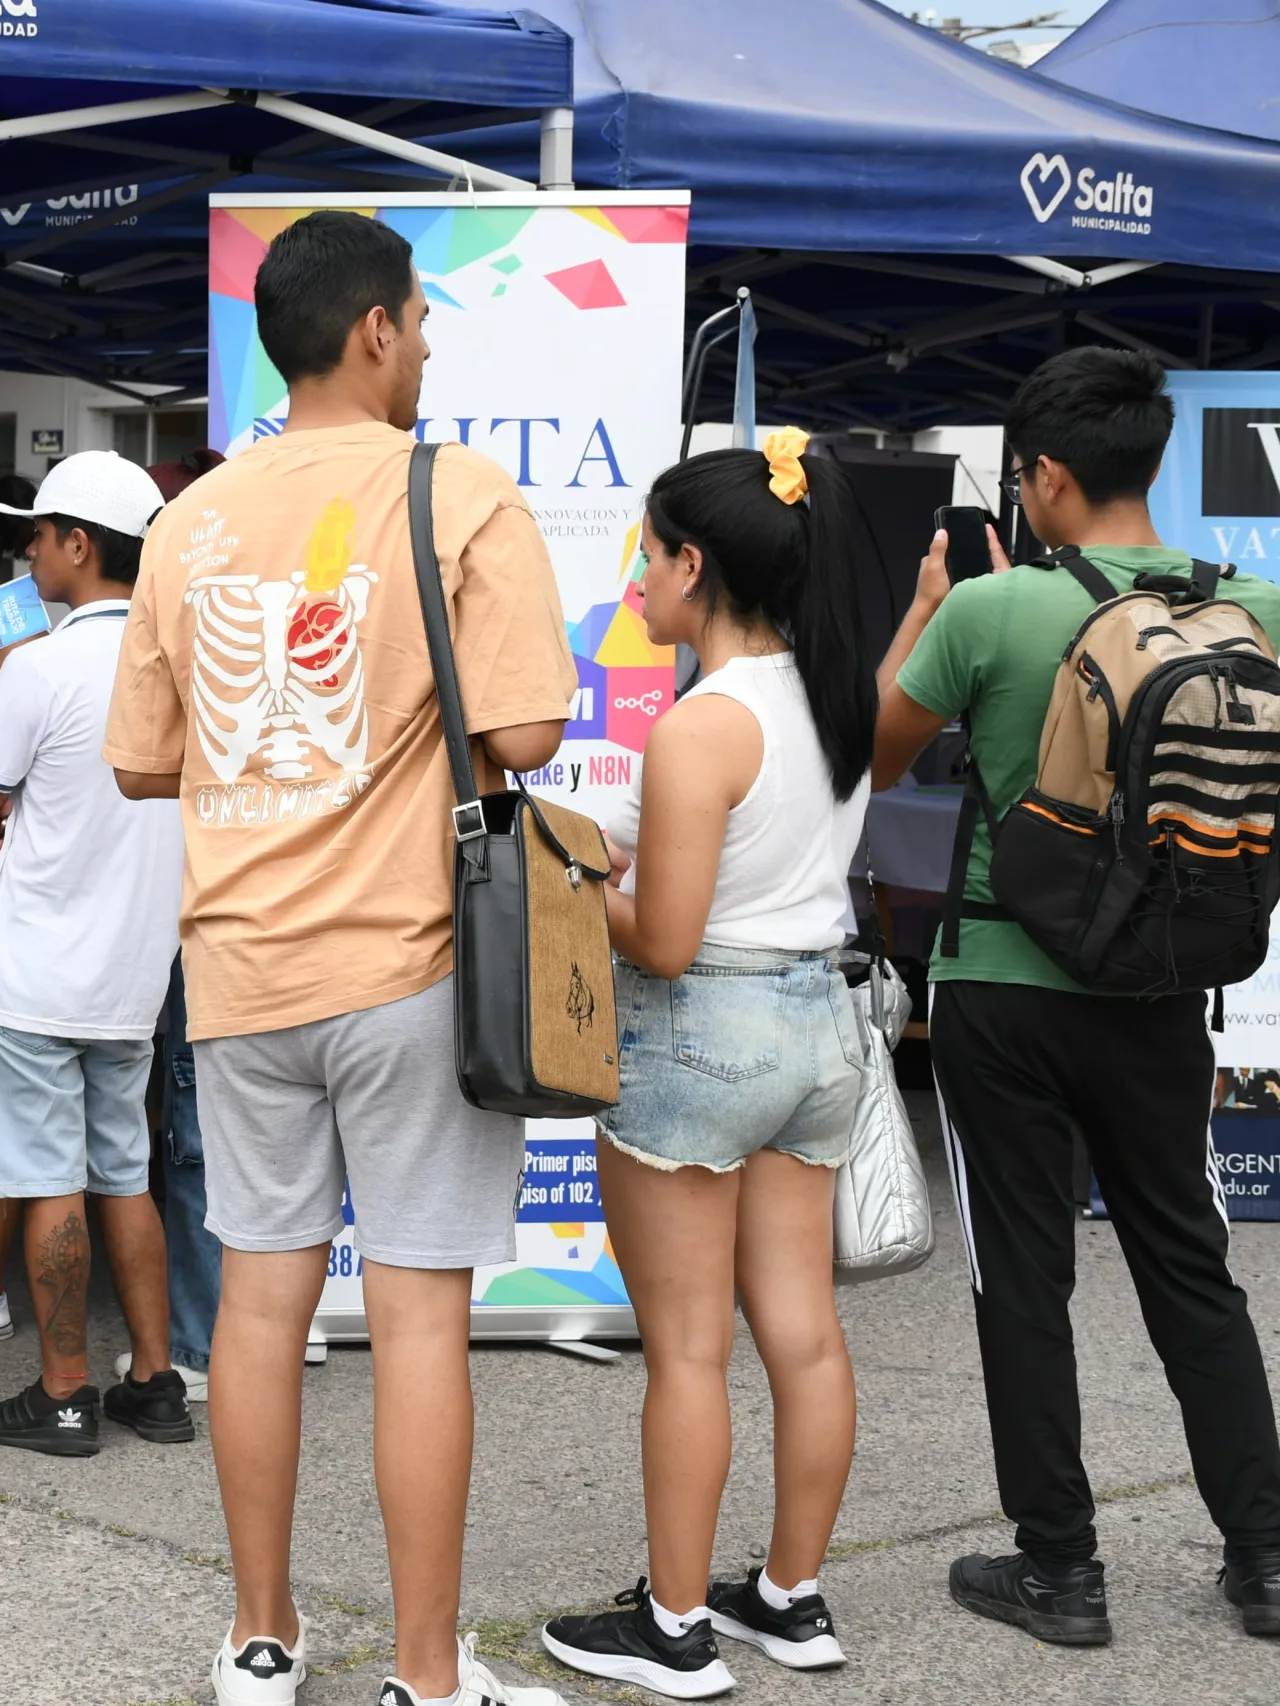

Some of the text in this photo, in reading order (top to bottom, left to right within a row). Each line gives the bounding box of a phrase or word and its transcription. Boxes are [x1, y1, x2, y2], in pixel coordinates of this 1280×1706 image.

[1074, 167, 1153, 217] Salta
[1071, 215, 1151, 235] MUNICIPALIDAD
[534, 508, 632, 520] NNOVACION Y
[570, 762, 582, 793] y
[589, 755, 631, 786] N8N
[524, 1150, 570, 1173] Primer
[520, 1181, 594, 1209] piso of 102
[250, 1659, 276, 1668] adidas
